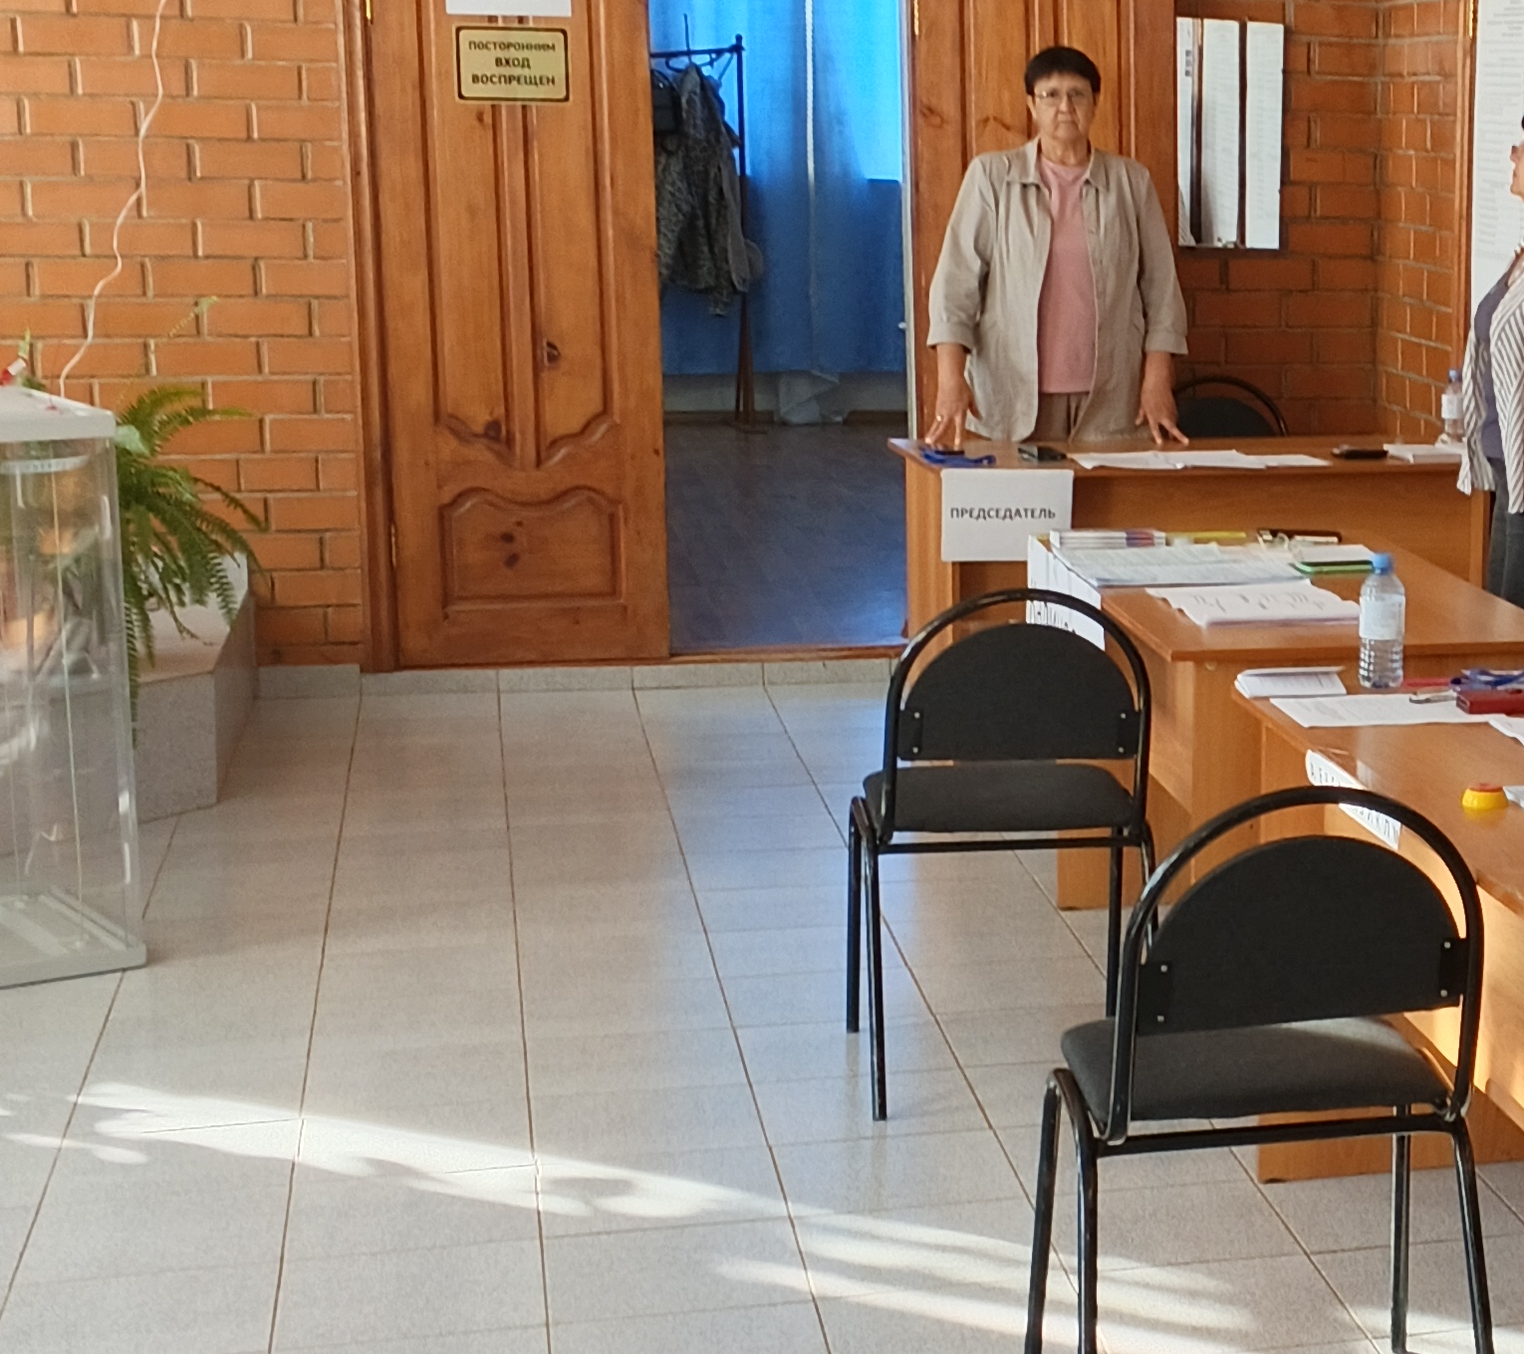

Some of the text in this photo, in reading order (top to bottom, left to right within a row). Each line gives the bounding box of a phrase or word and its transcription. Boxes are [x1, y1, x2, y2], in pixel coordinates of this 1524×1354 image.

[468, 40, 556, 53] ПОСТОРОННИМ
[494, 56, 531, 70] ВХОД
[471, 73, 556, 88] ВОСПРЕЩЕН
[950, 507, 1056, 521] ПРЕДСЕДАТЕЛЬ
